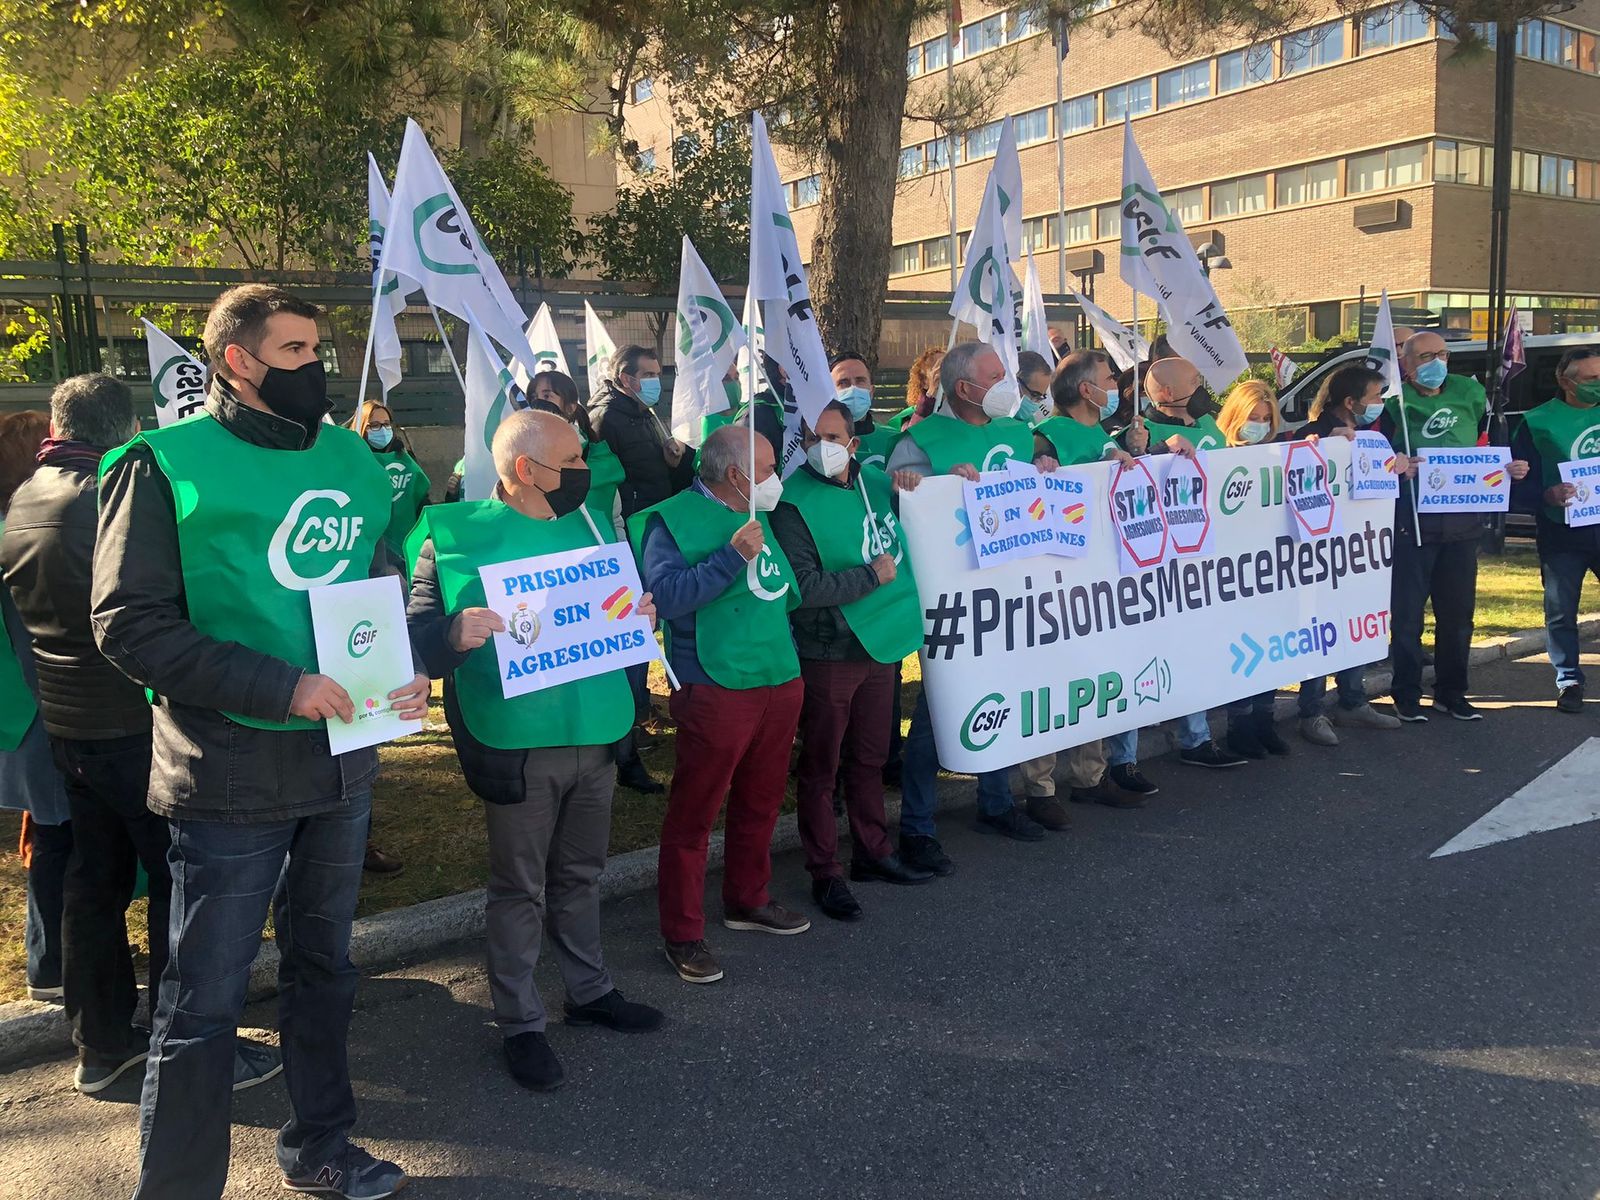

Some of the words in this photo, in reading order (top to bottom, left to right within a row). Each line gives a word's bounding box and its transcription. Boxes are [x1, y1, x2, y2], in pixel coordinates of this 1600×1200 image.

[1189, 325, 1225, 367] Valladolid
[1428, 454, 1501, 465] PRISIONES
[389, 472, 412, 489] SIF
[1453, 474, 1477, 484] SIN
[1421, 493, 1505, 505] AGRESIONES
[1123, 516, 1163, 541] AGRESIONES
[1165, 508, 1206, 526] AGRESIONES
[502, 557, 621, 596] PRISIONES
[924, 520, 1394, 661] #PrisionesMereceRespeto
[553, 602, 591, 627] SIN
[1348, 609, 1389, 643] UGT
[1268, 616, 1338, 663] acaip
[506, 629, 646, 680] AGRESIONES
[1021, 671, 1128, 738] II.PP.
